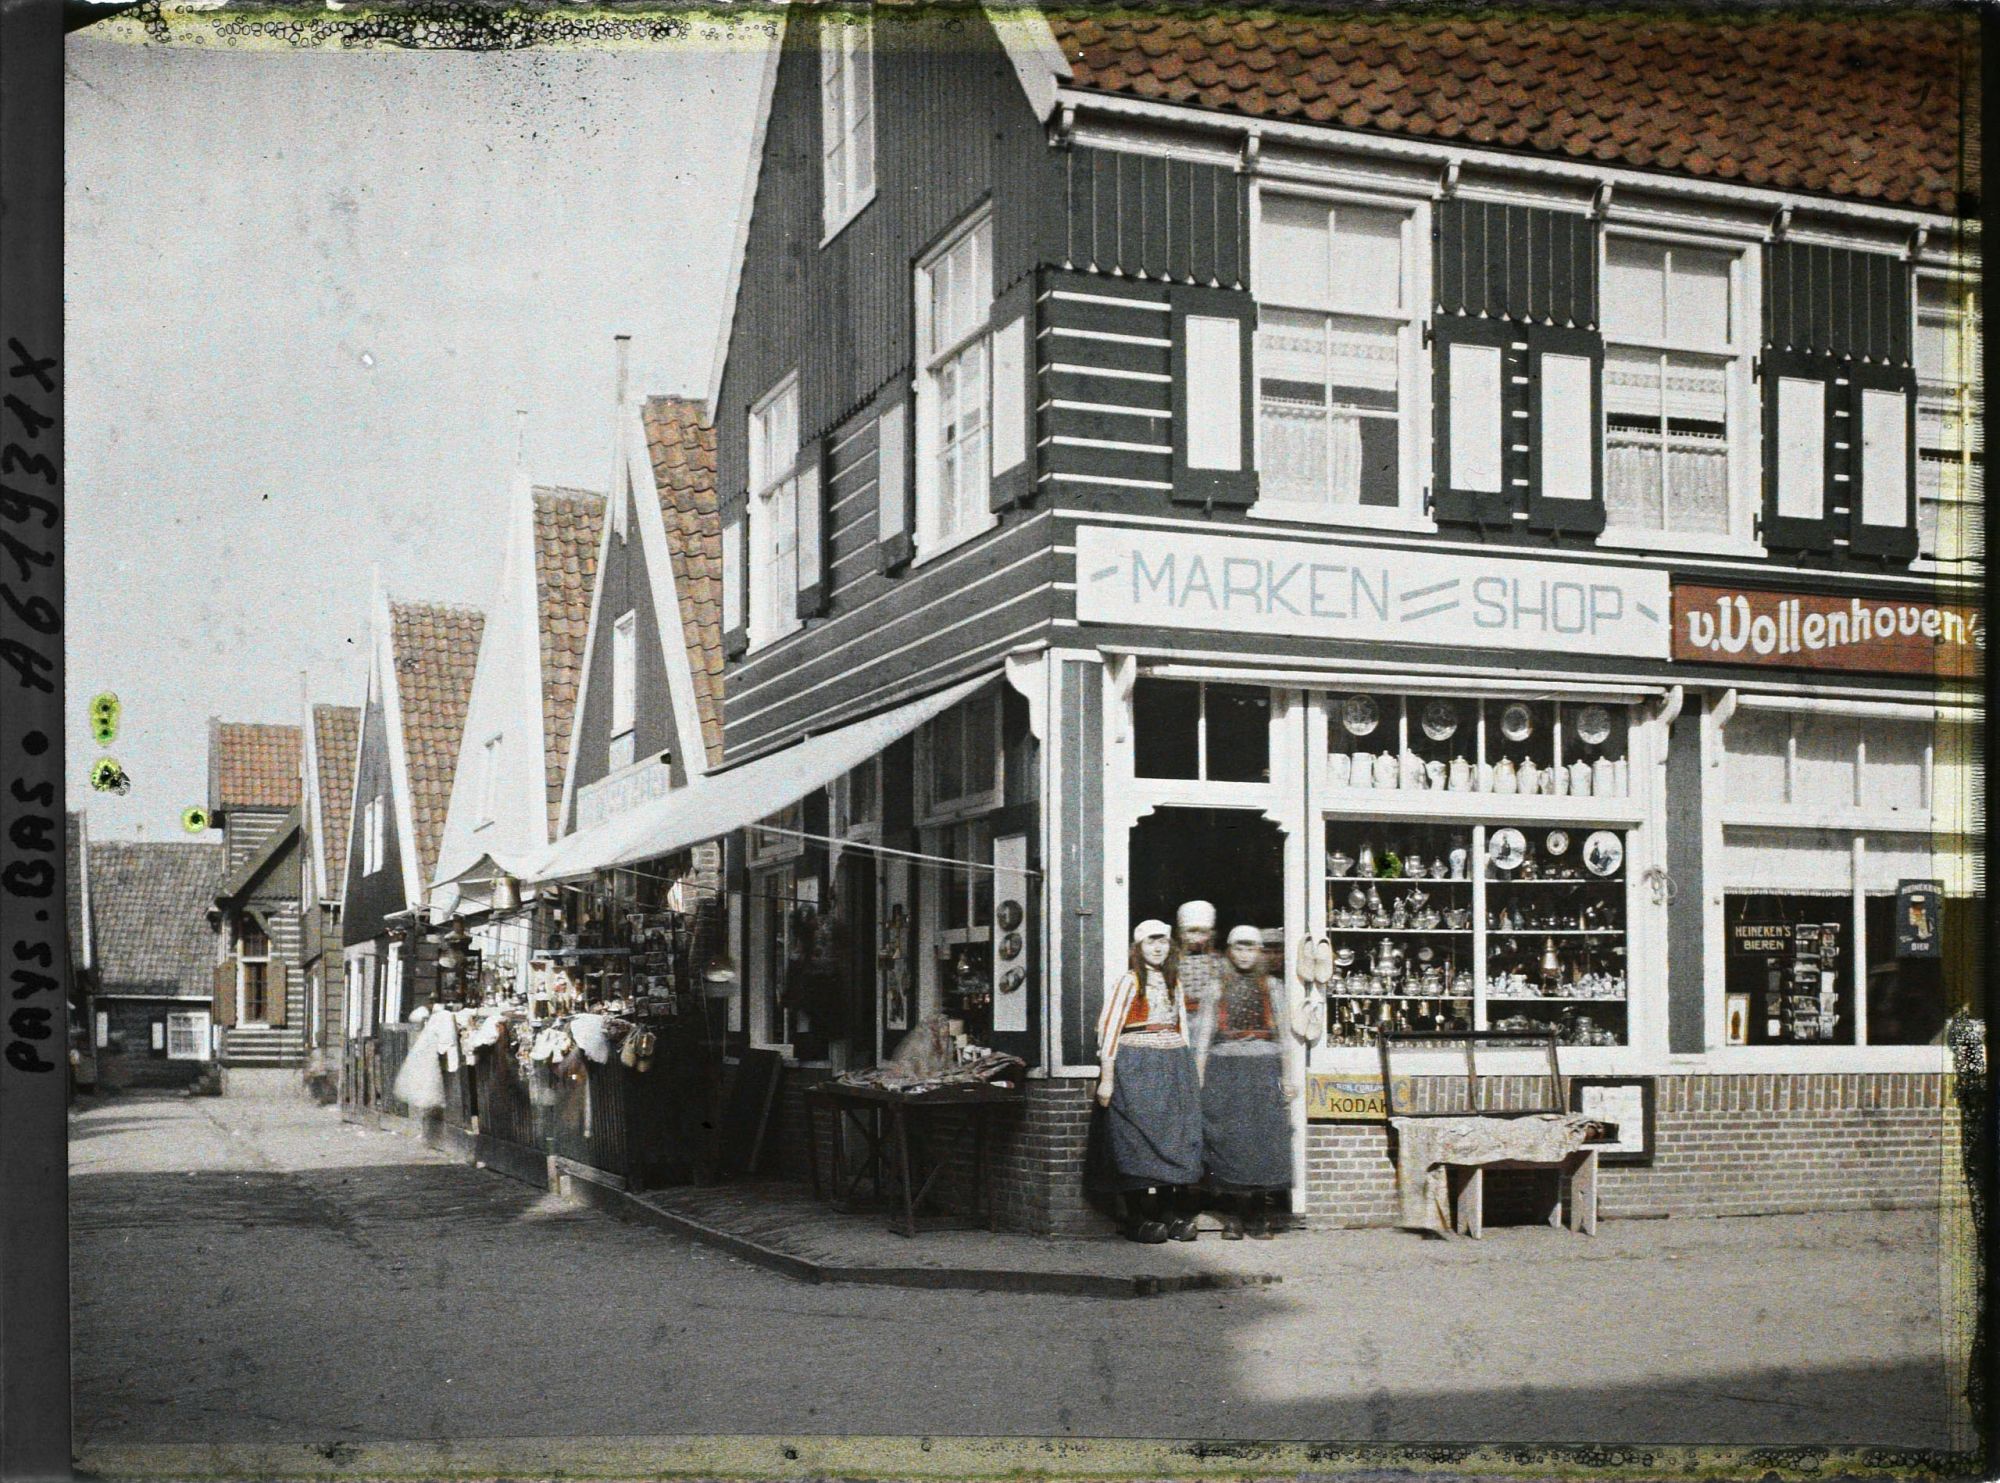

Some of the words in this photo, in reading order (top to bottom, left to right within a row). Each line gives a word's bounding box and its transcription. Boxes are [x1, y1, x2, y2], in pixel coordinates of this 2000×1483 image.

[1131, 549, 1389, 622] MARKEN
[1473, 575, 1624, 635] SHOP
[1735, 925, 1791, 938] HEINEKEN'S
[1743, 940, 1784, 950] BIEREN
